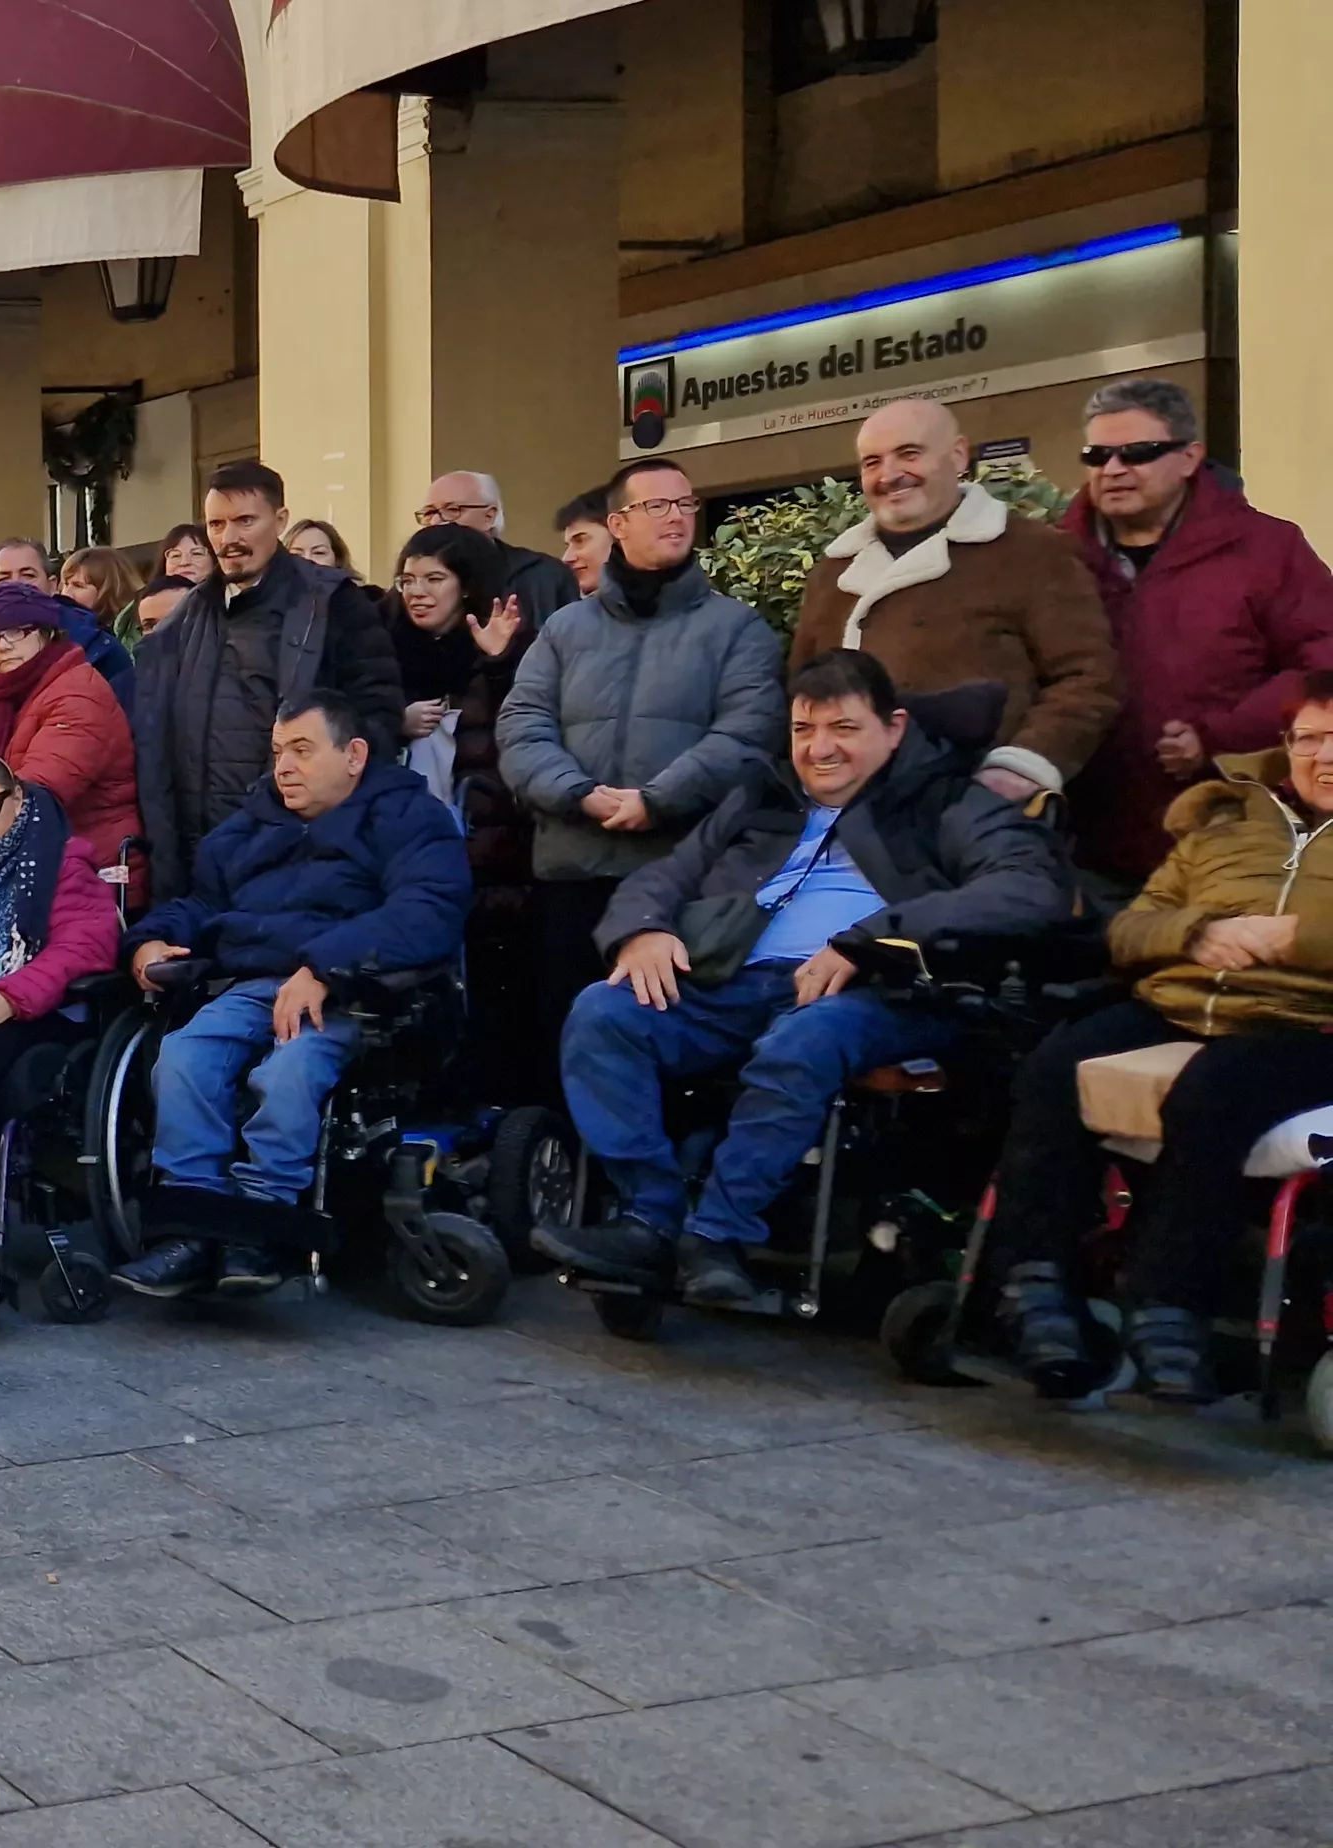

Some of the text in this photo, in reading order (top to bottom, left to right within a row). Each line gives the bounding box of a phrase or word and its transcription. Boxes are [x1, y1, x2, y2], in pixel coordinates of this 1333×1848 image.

[681, 317, 988, 410] Apuestas del Estado
[763, 418, 776, 430] La
[779, 415, 786, 426] 7
[790, 412, 804, 425] de
[808, 405, 849, 421] Huesca
[980, 377, 988, 390] 7
